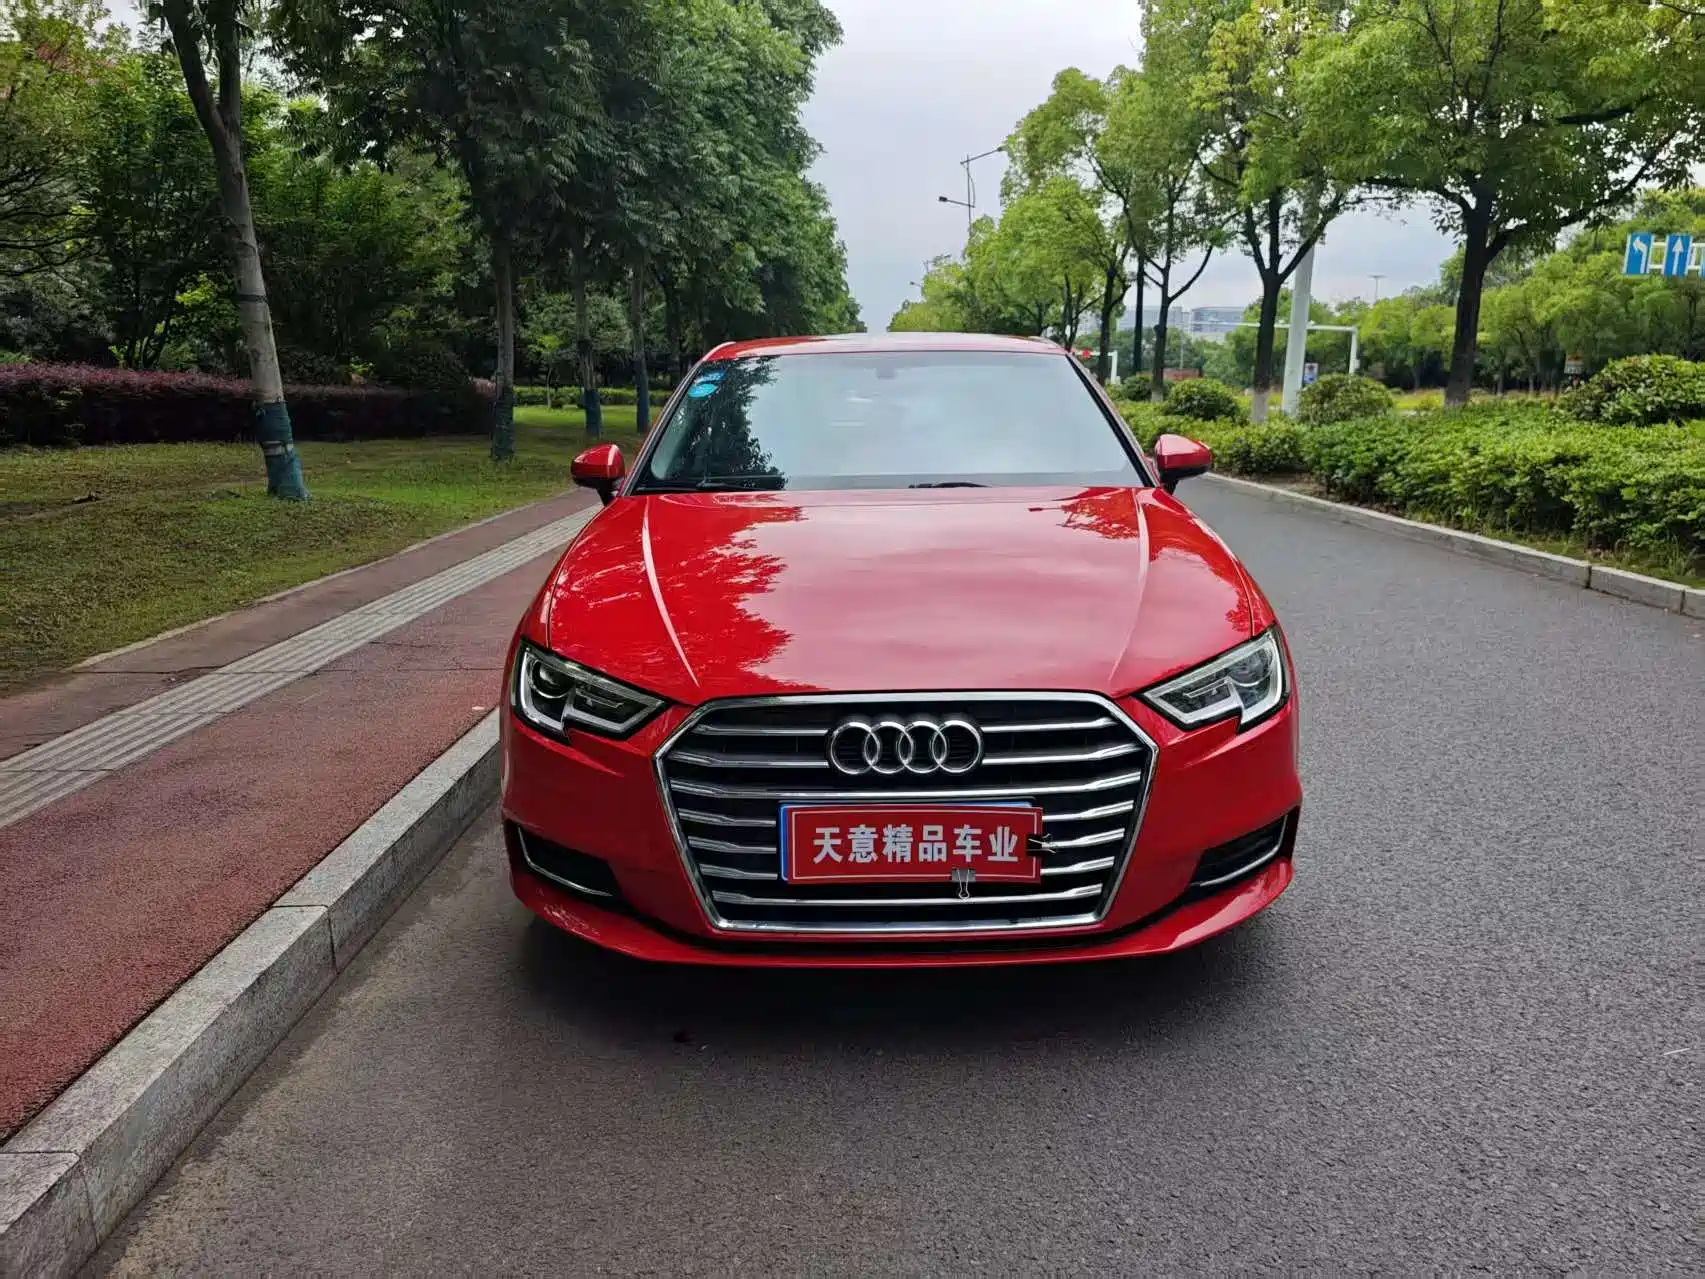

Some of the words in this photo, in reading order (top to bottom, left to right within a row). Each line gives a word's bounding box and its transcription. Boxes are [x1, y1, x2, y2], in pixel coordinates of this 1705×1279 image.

[813, 823, 1018, 864] 天意精品车业
